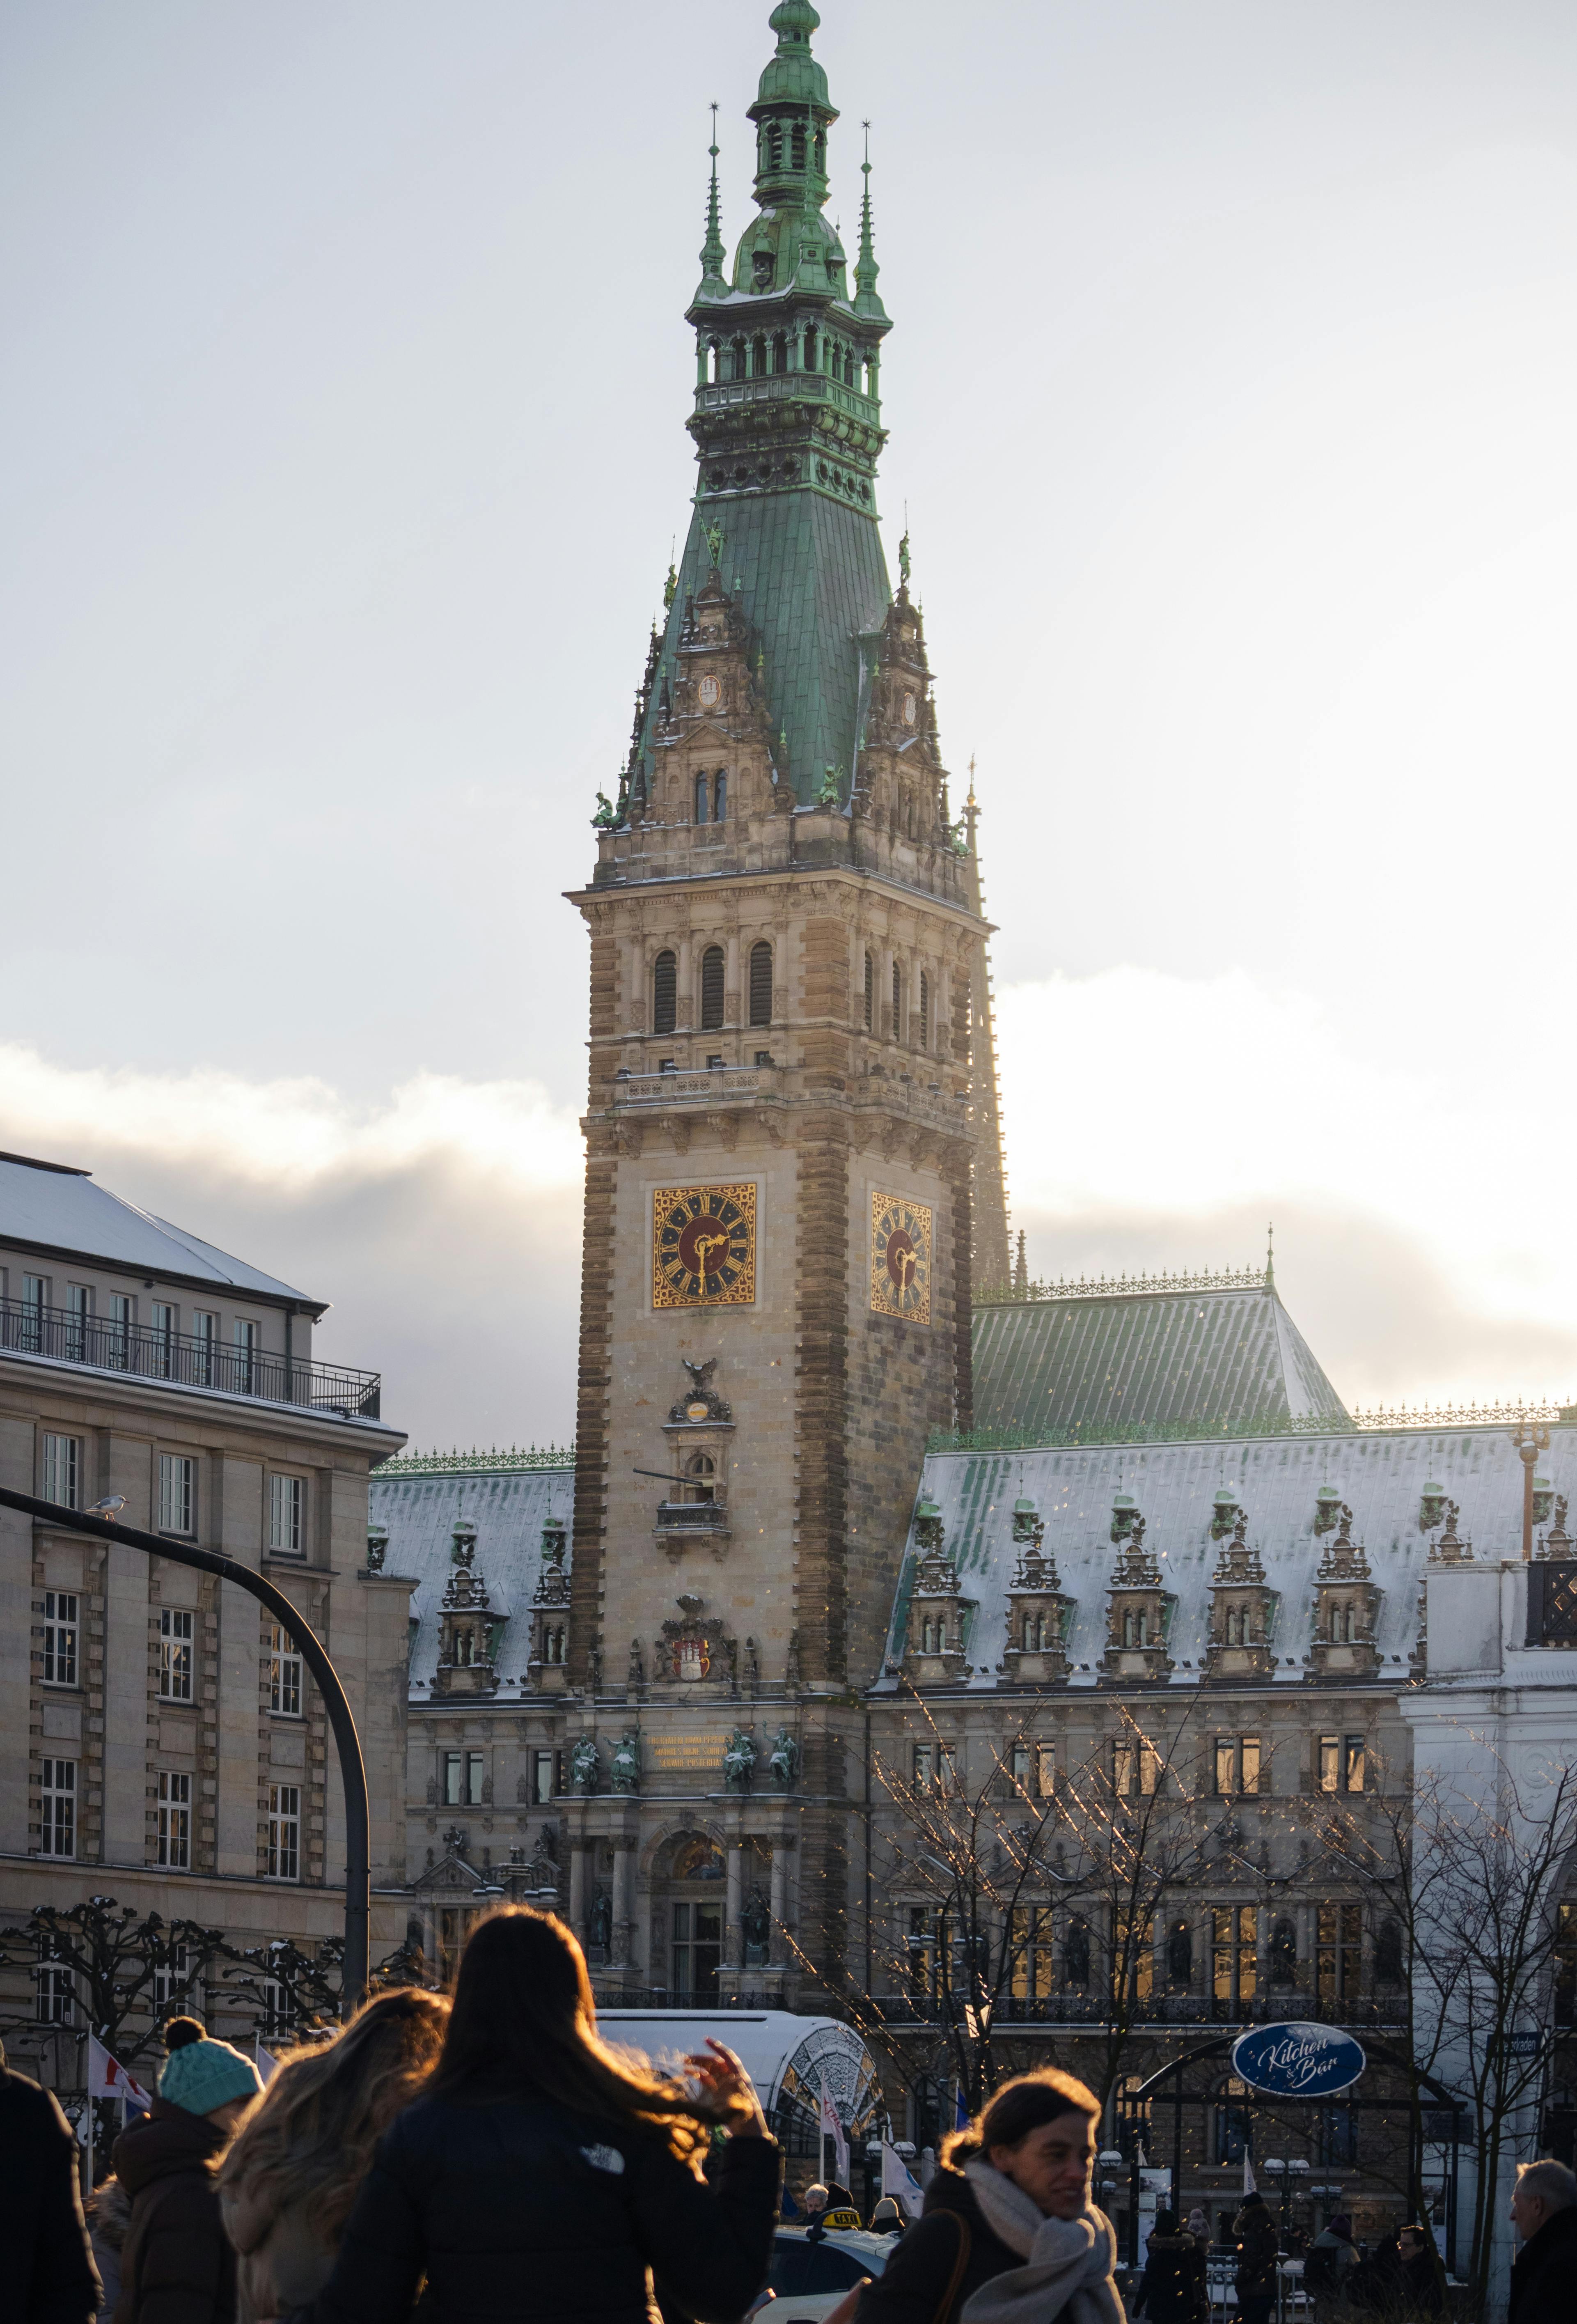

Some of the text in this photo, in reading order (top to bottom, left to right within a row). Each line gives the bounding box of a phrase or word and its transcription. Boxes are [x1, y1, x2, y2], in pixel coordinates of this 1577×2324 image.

[699, 1196, 710, 1214] XII
[1258, 2038, 1328, 2072] Kitchen
[1292, 2056, 1338, 2088] Bar
[837, 2214, 856, 2223] TAXI
